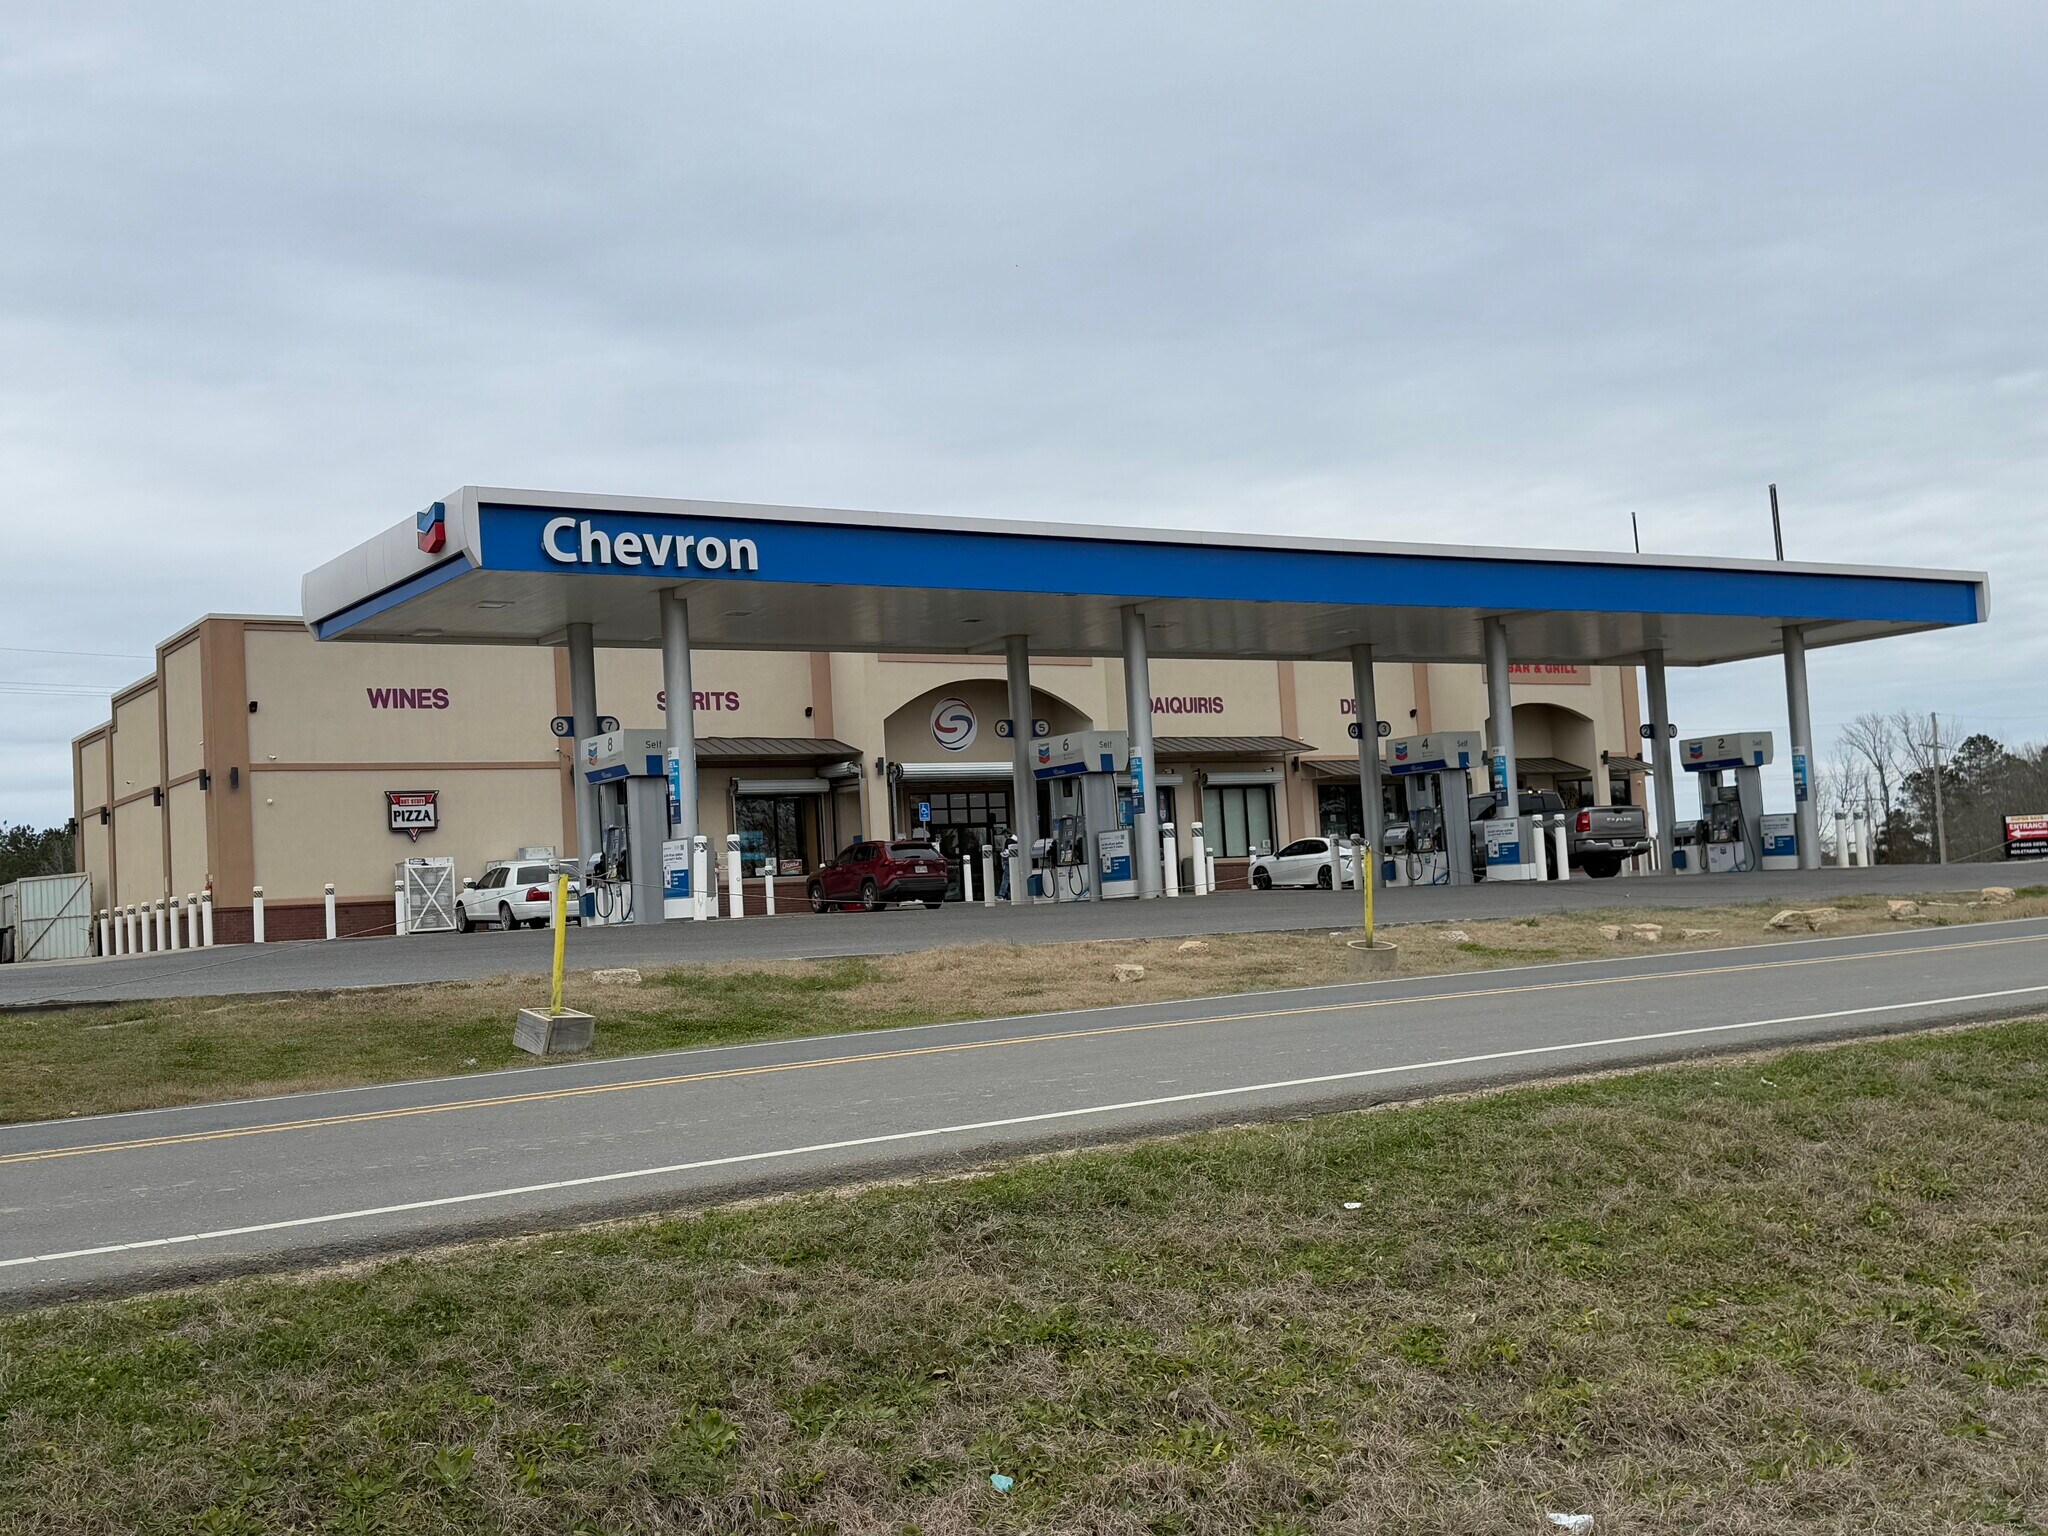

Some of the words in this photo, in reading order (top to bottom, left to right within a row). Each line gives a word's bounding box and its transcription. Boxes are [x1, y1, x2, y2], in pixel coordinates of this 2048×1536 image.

[542, 516, 759, 570] Chevron
[366, 688, 450, 709] WINES
[656, 691, 740, 711] SRITS
[1150, 696, 1224, 714] AIQUIRIS
[555, 721, 564, 731] 8
[605, 721, 613, 731] 7
[999, 724, 1006, 733] 6
[1038, 723, 1046, 732] 5
[1350, 726, 1357, 735] 4
[1381, 724, 1387, 733] 3
[1643, 726, 1649, 735] 2
[607, 737, 613, 752] 8
[645, 740, 662, 749] Self
[1062, 738, 1069, 751] 6
[1099, 741, 1112, 749] Self
[1422, 738, 1429, 749] 4
[1457, 740, 1468, 748] Self
[1717, 738, 1725, 749] 2
[393, 809, 432, 822] PIZZA
[2009, 822, 2048, 830] ENTRANCE
